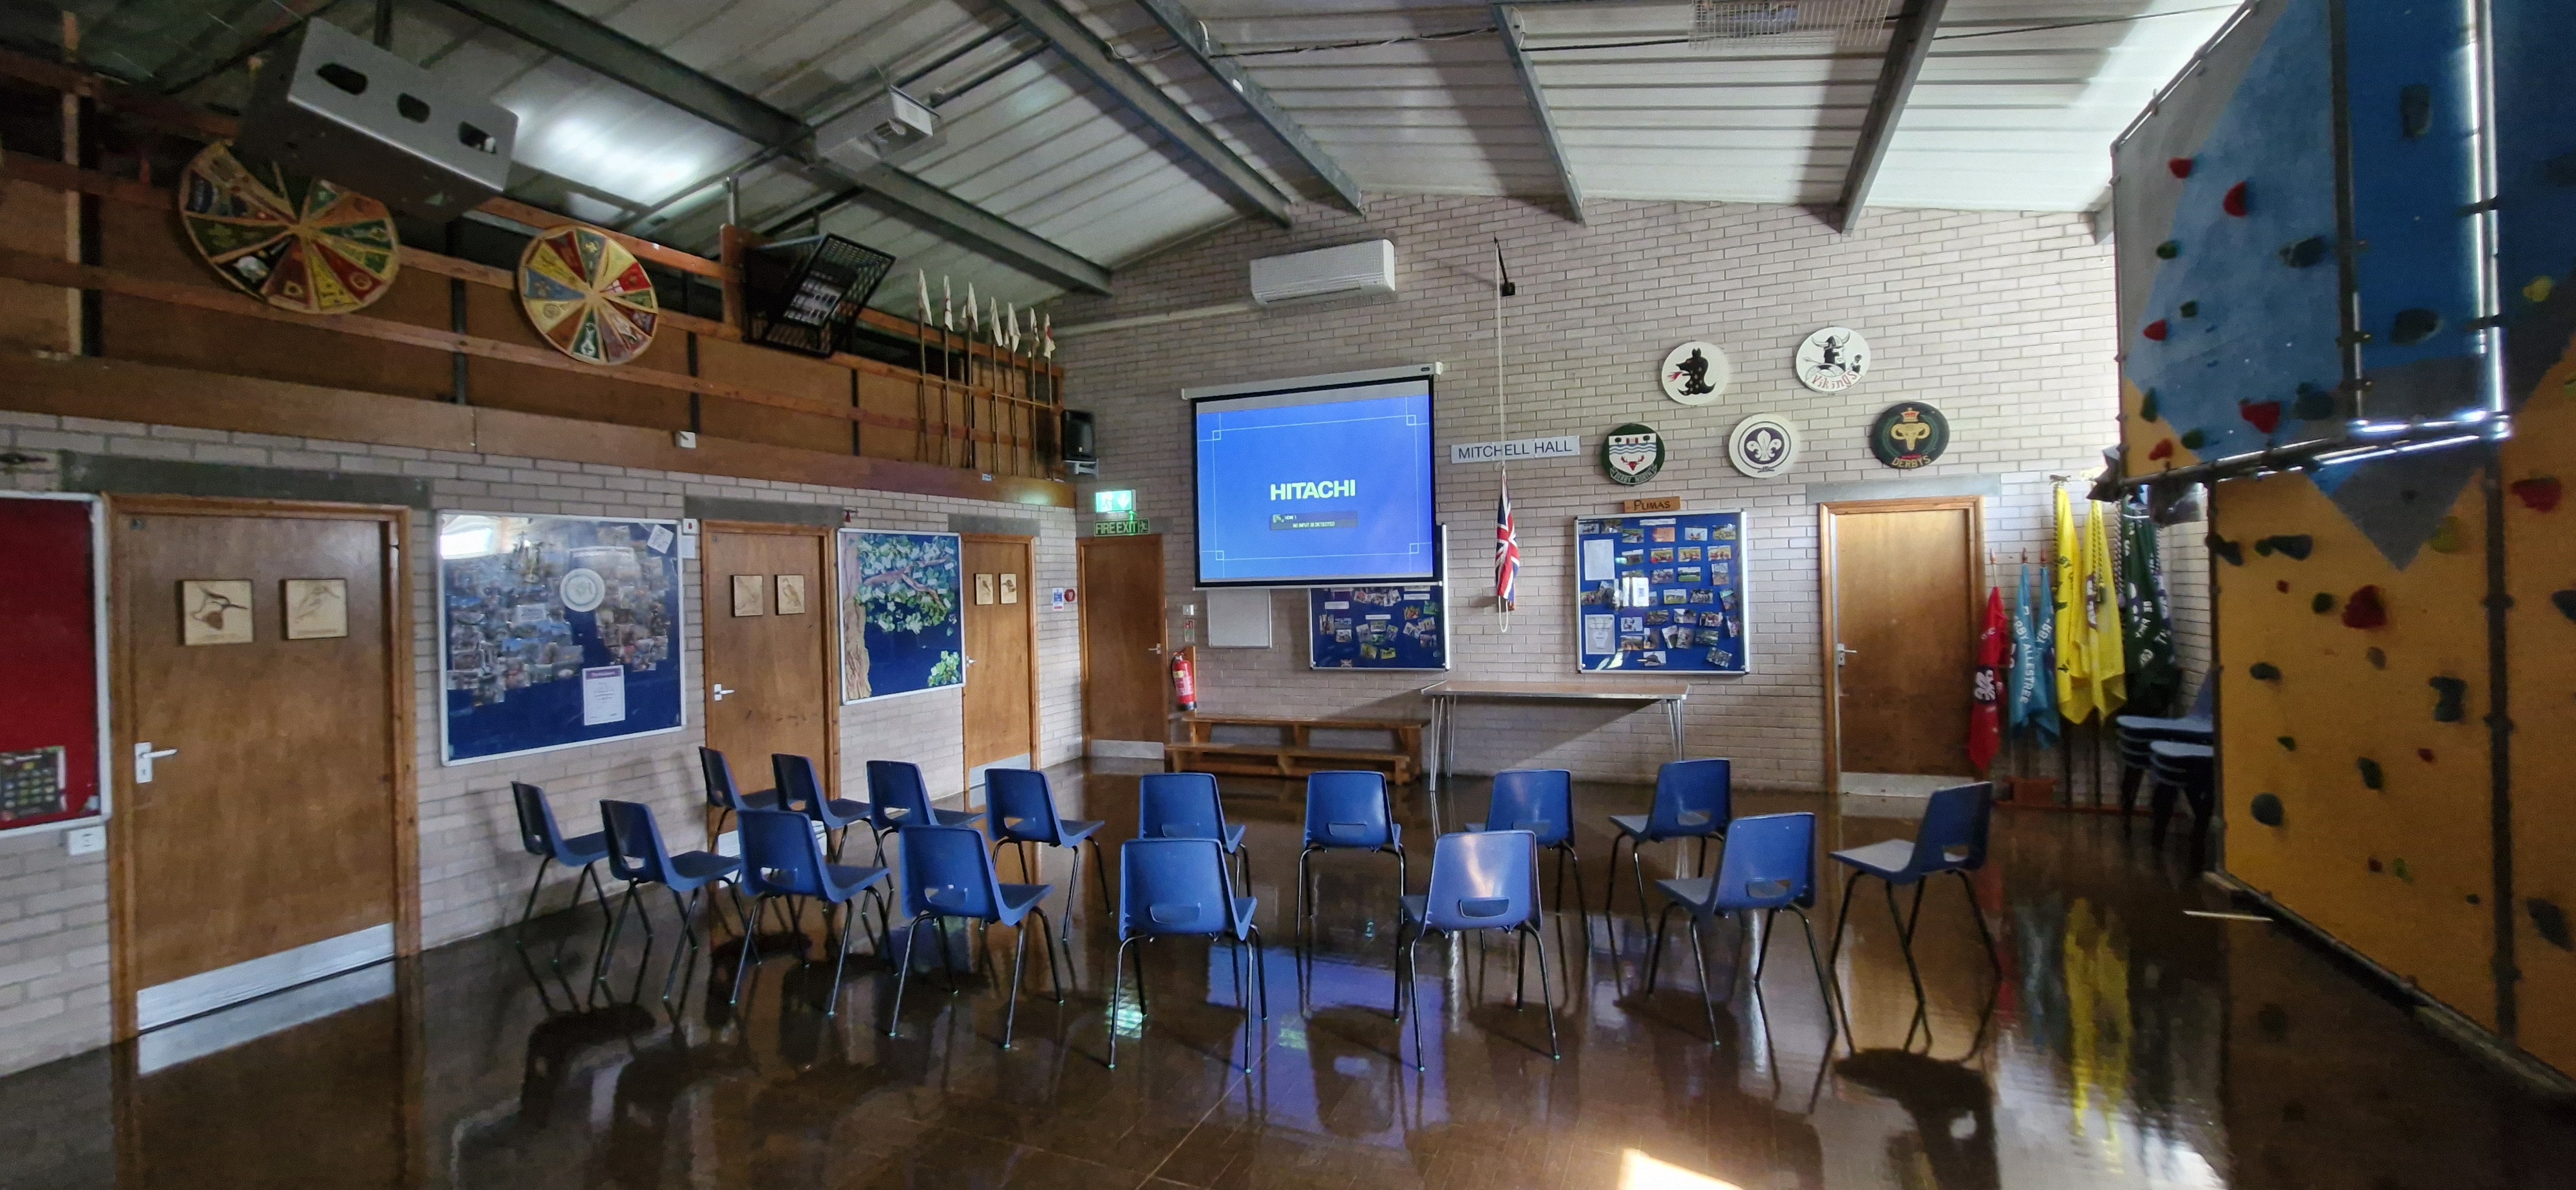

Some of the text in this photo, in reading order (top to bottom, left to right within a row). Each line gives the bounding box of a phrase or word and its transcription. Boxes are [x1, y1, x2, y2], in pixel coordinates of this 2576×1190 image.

[1812, 370, 1857, 389] Vikings
[1459, 440, 1573, 458] MITCHELL HALL
[1891, 455, 1931, 469] DERBYS
[1271, 479, 1356, 500] HITACHI
[1095, 521, 1138, 534] FIRE EXIT
